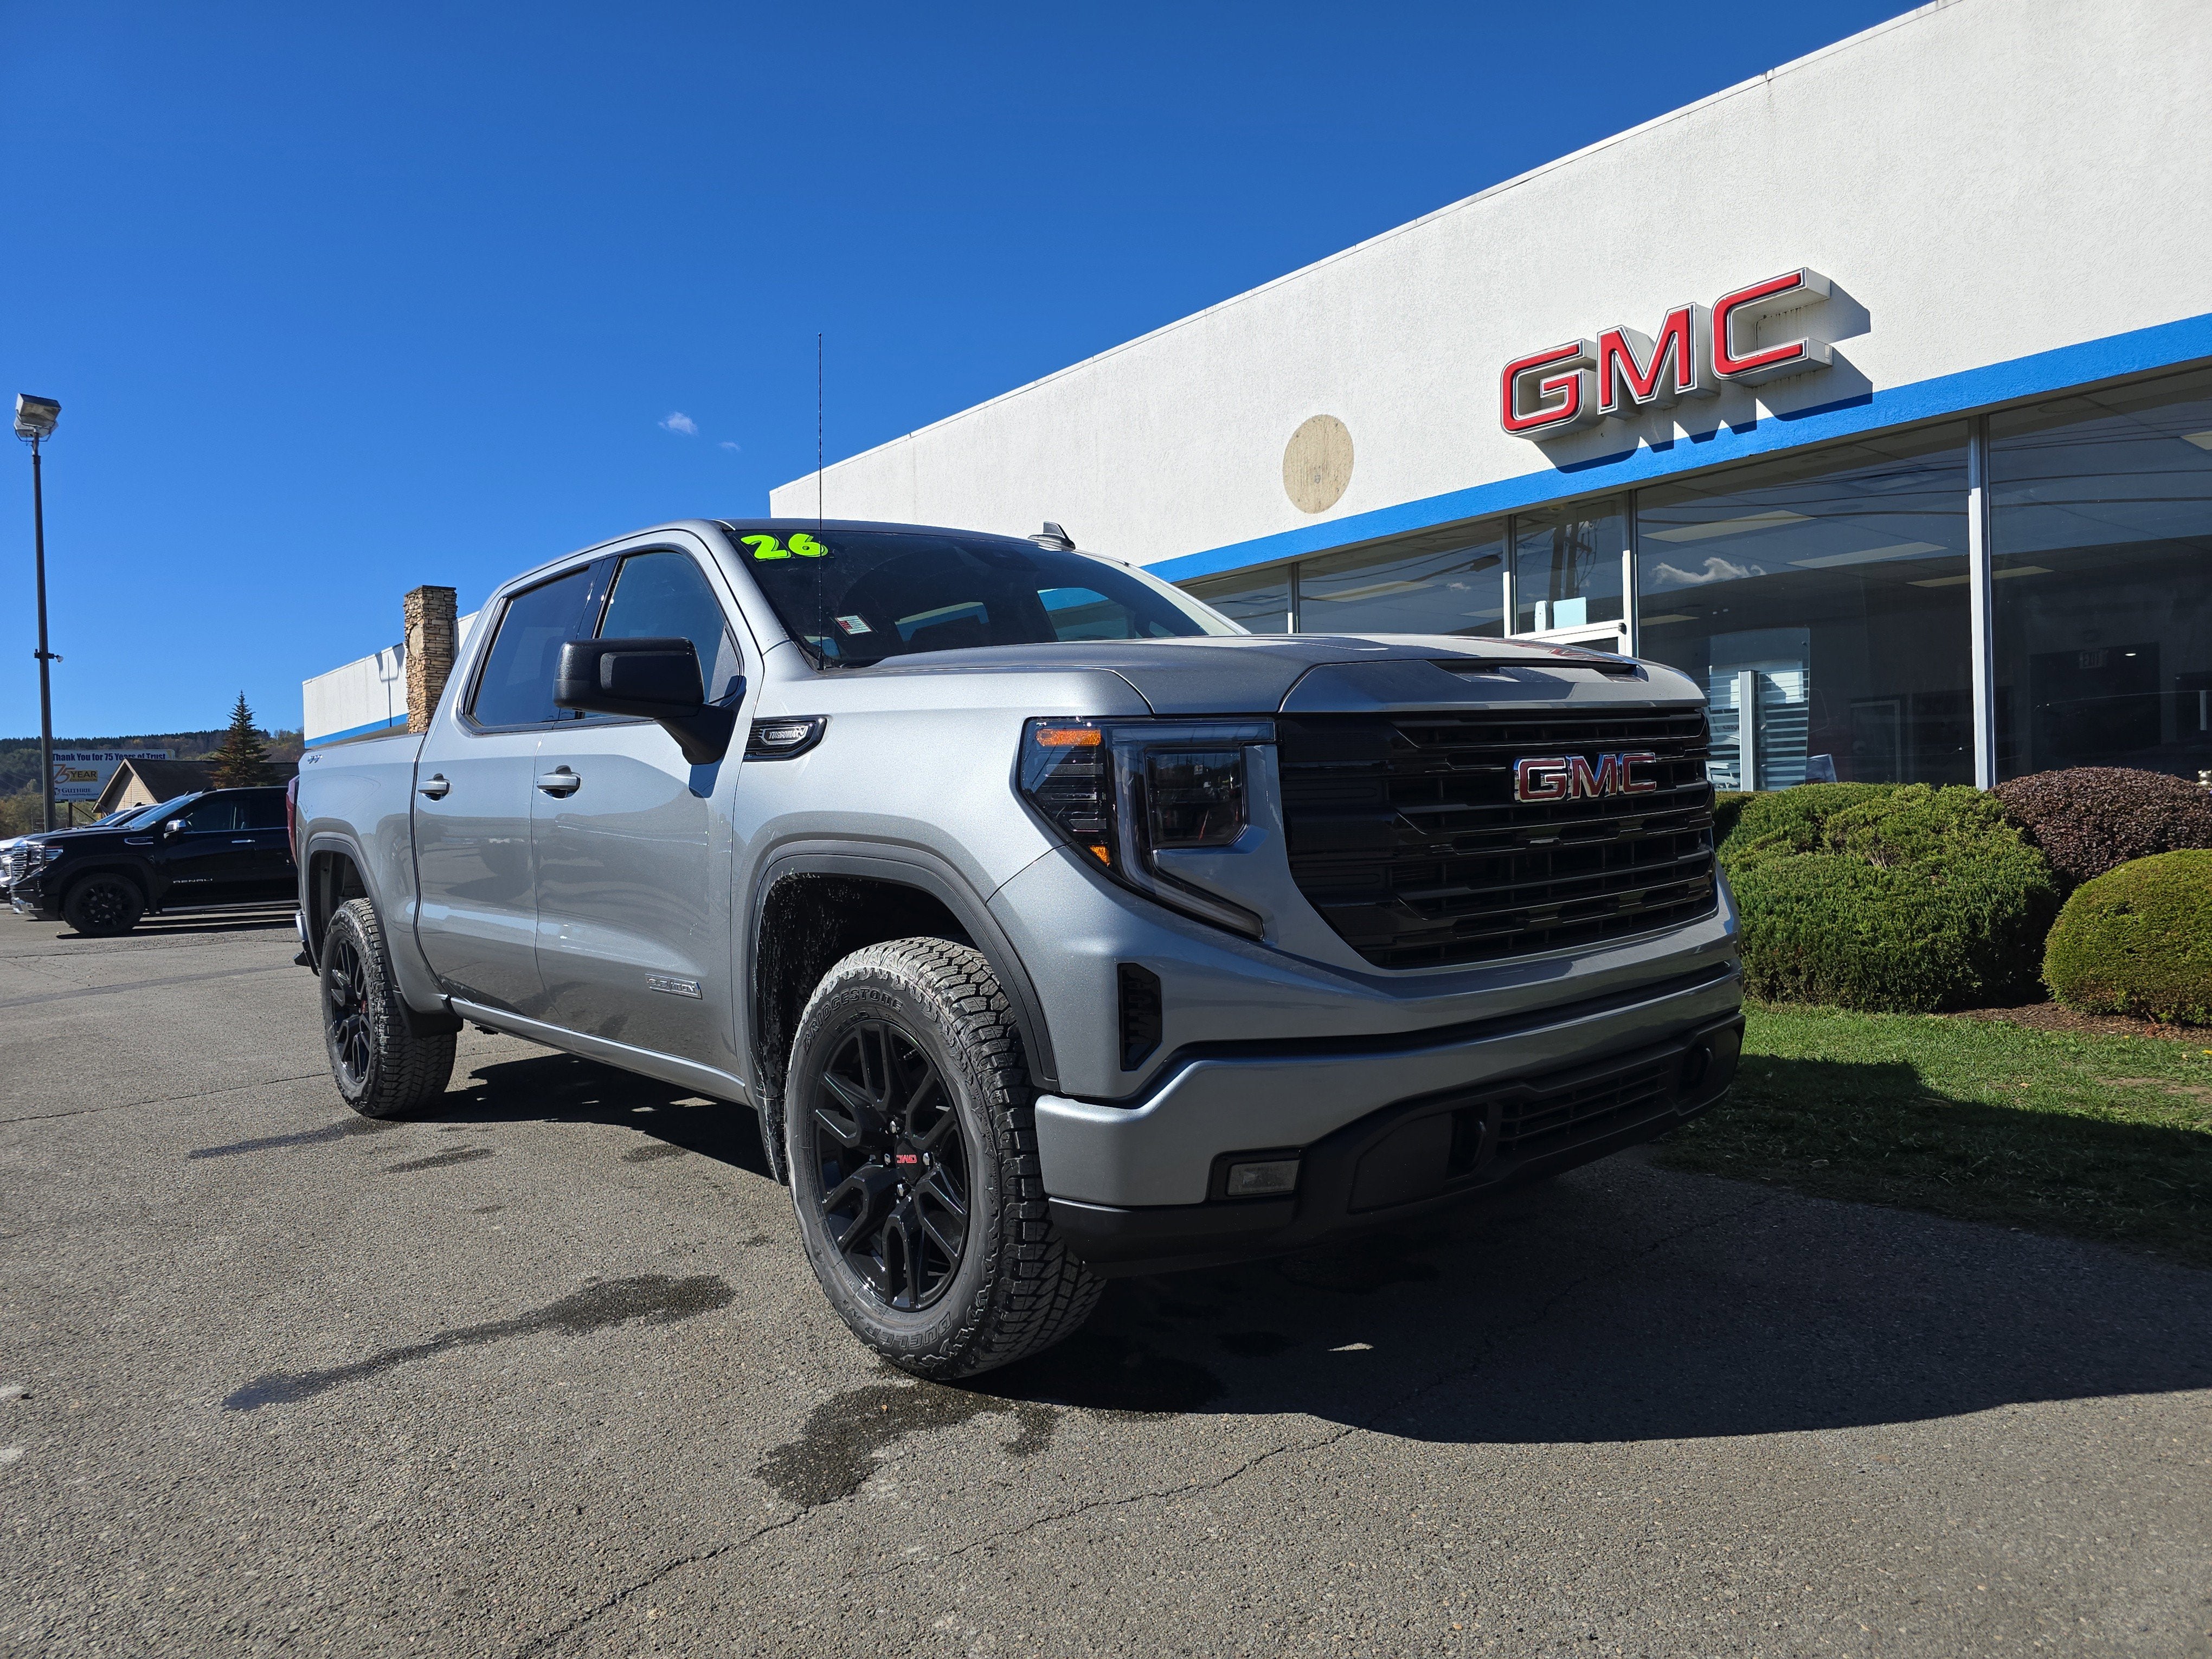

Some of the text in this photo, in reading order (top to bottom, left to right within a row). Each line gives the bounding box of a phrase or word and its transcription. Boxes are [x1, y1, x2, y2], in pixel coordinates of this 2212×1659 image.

[1500, 266, 1814, 437] GMC
[741, 533, 828, 561] 26
[769, 726, 806, 739] TURBOMAX
[53, 764, 75, 784] 75
[1513, 751, 1657, 803] GMC
[802, 985, 904, 1056] BRIDGESTONE
[896, 1154, 917, 1163] GMC
[864, 1310, 952, 1350] DUELER
